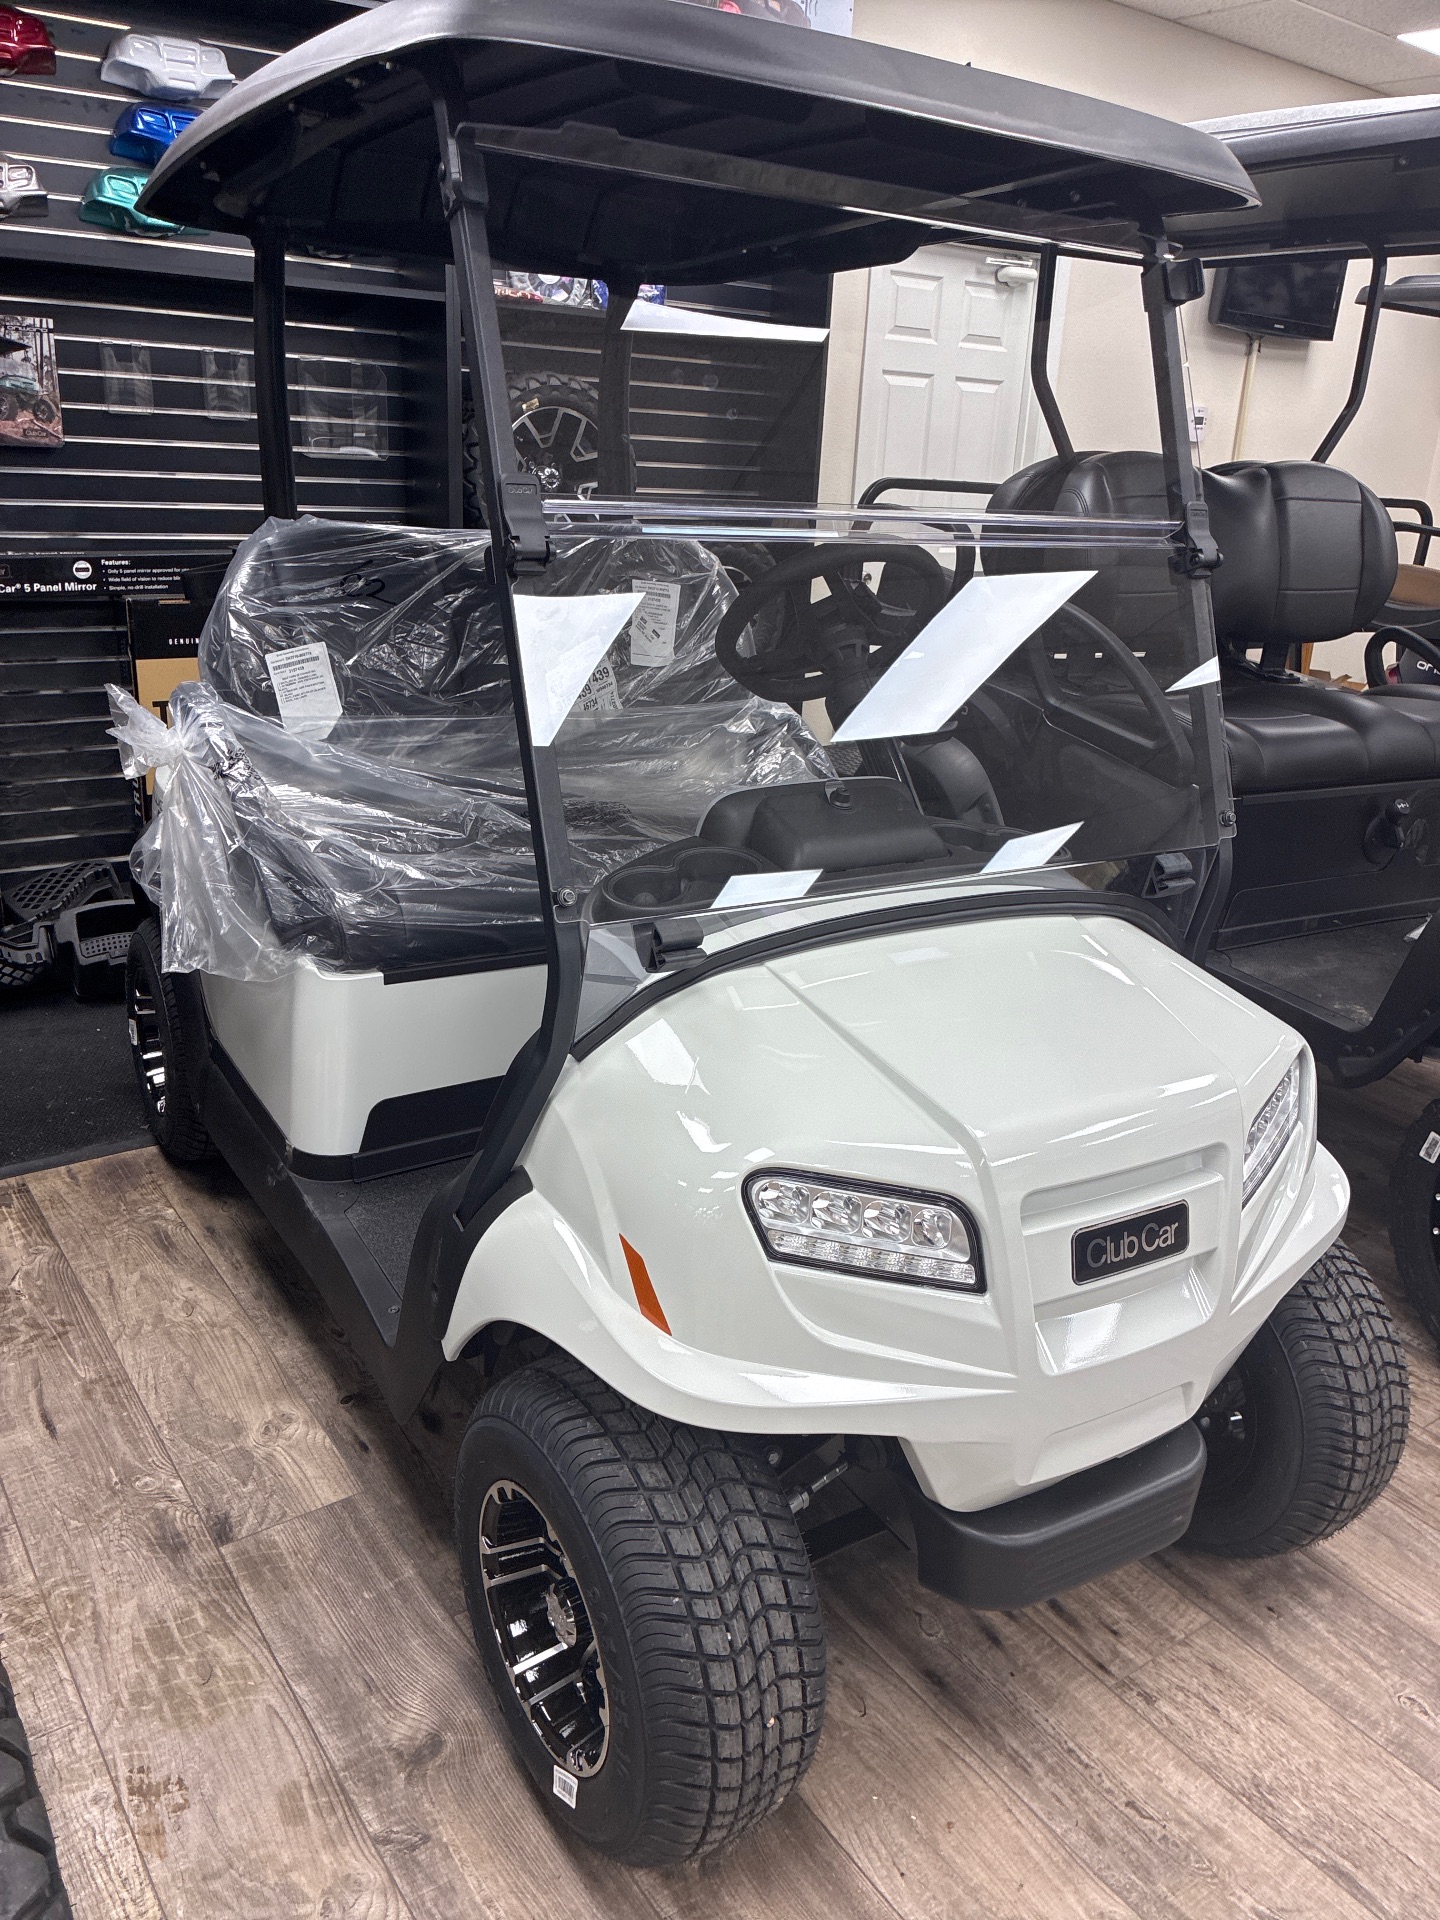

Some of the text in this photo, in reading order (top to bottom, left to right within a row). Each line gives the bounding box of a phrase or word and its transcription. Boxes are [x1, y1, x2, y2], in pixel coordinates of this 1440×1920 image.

[24, 583, 31, 593] 5
[33, 582, 62, 592] Panel
[64, 582, 97, 592] Mirror
[592, 666, 610, 683] 439
[1086, 1222, 1179, 1268] Club Car
